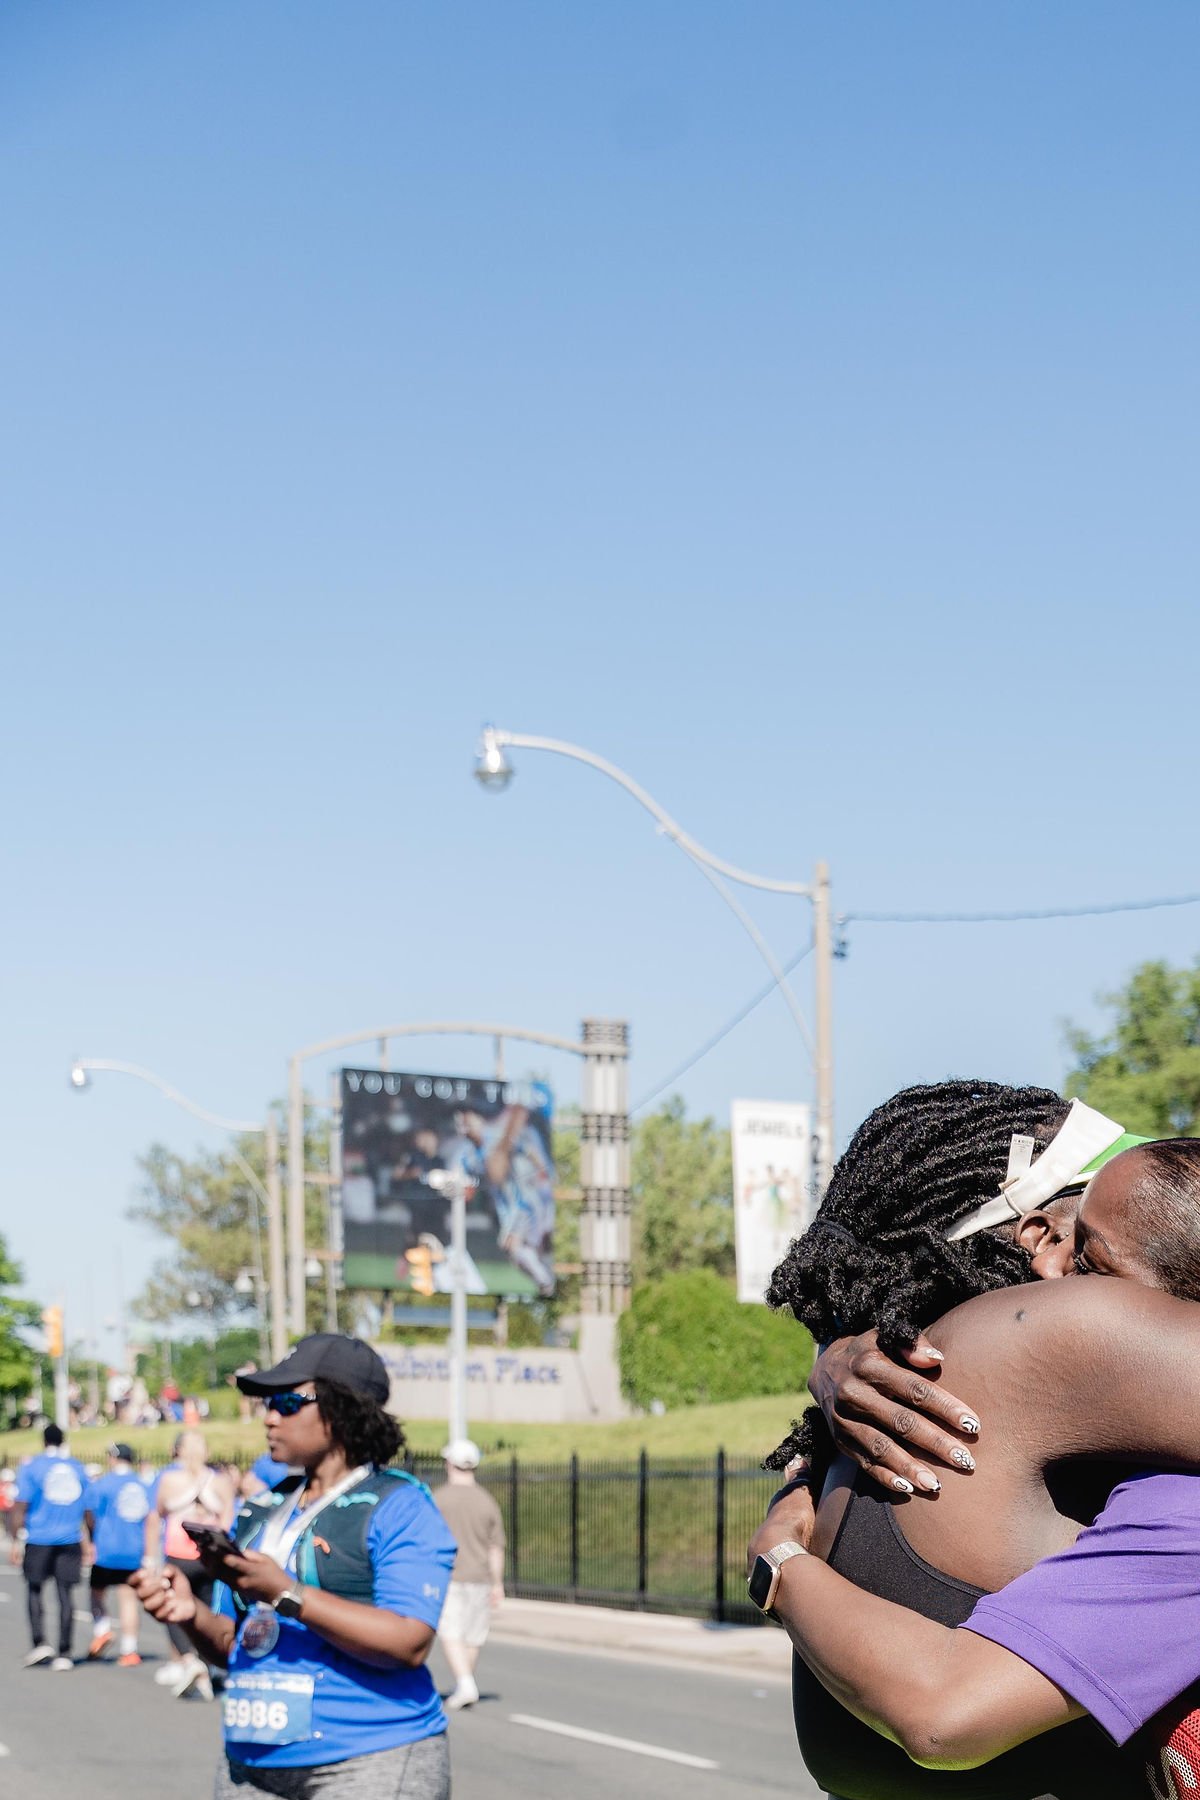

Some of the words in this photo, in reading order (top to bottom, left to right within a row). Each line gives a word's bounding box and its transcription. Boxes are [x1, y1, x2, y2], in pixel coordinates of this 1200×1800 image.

[346, 1070, 401, 1096] YOU
[414, 1076, 470, 1101] GOT
[495, 1356, 560, 1383] Place
[225, 1698, 289, 1730] 5986
